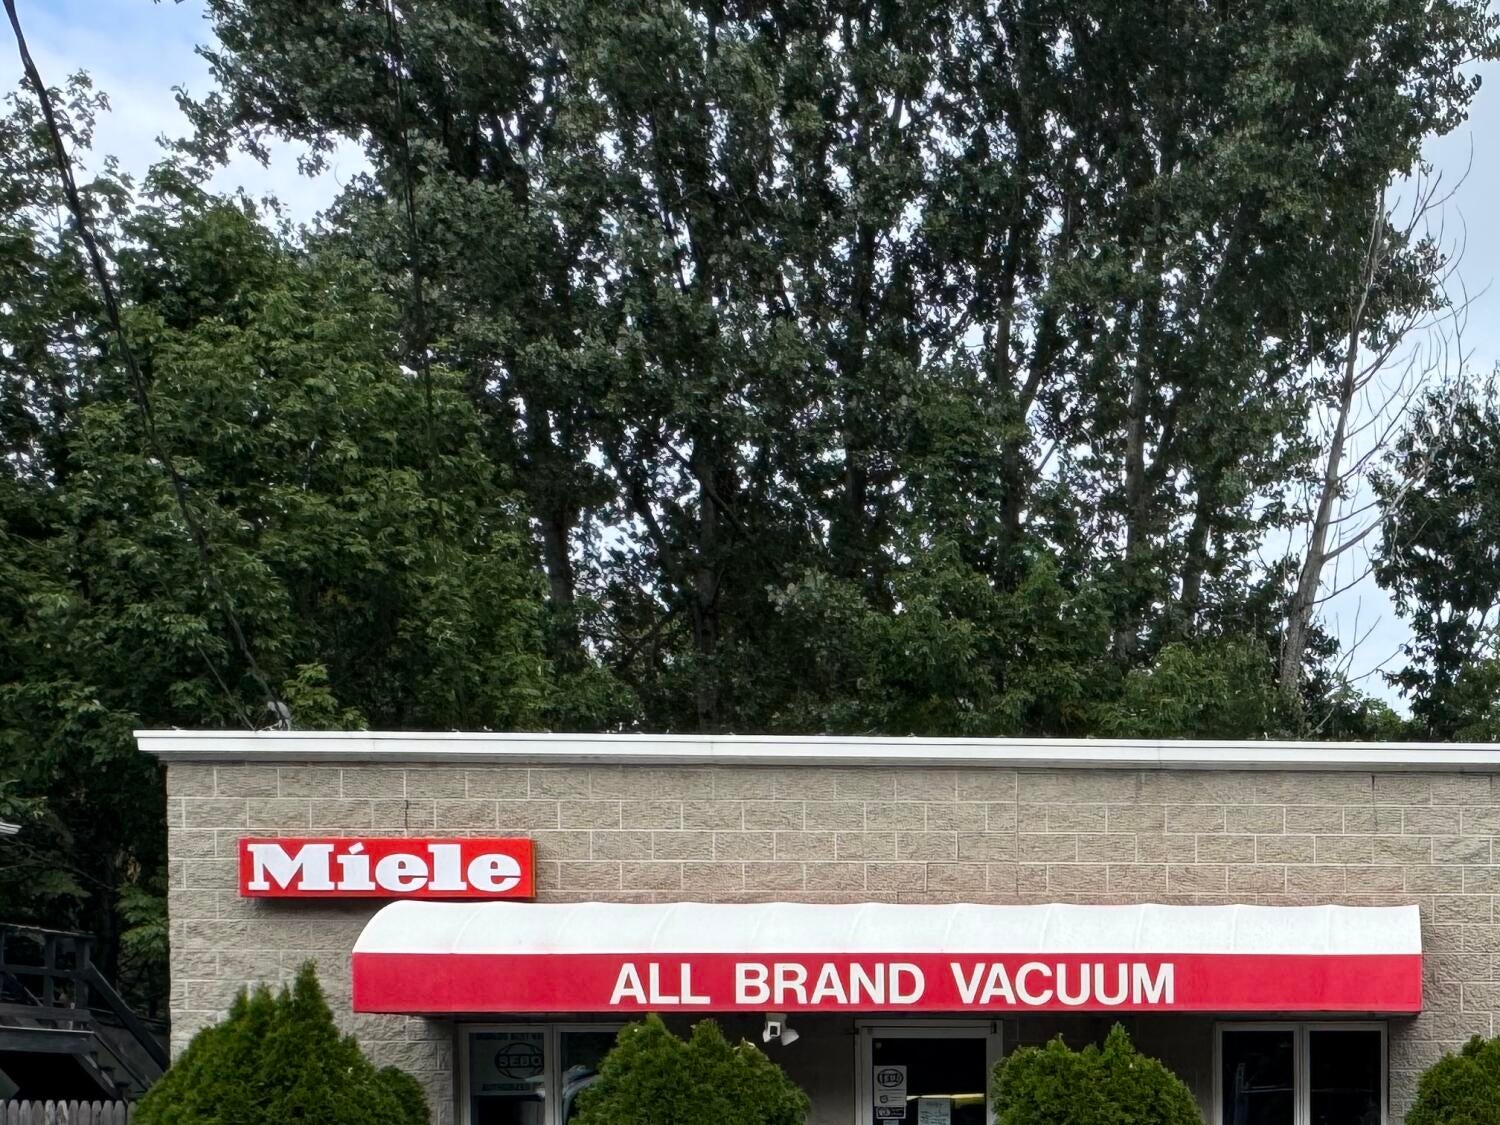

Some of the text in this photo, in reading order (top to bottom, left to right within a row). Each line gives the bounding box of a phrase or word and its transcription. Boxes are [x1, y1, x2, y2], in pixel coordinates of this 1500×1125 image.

[247, 842, 521, 892] Miele
[609, 962, 1174, 1005] ALL BRAND VACUUM
